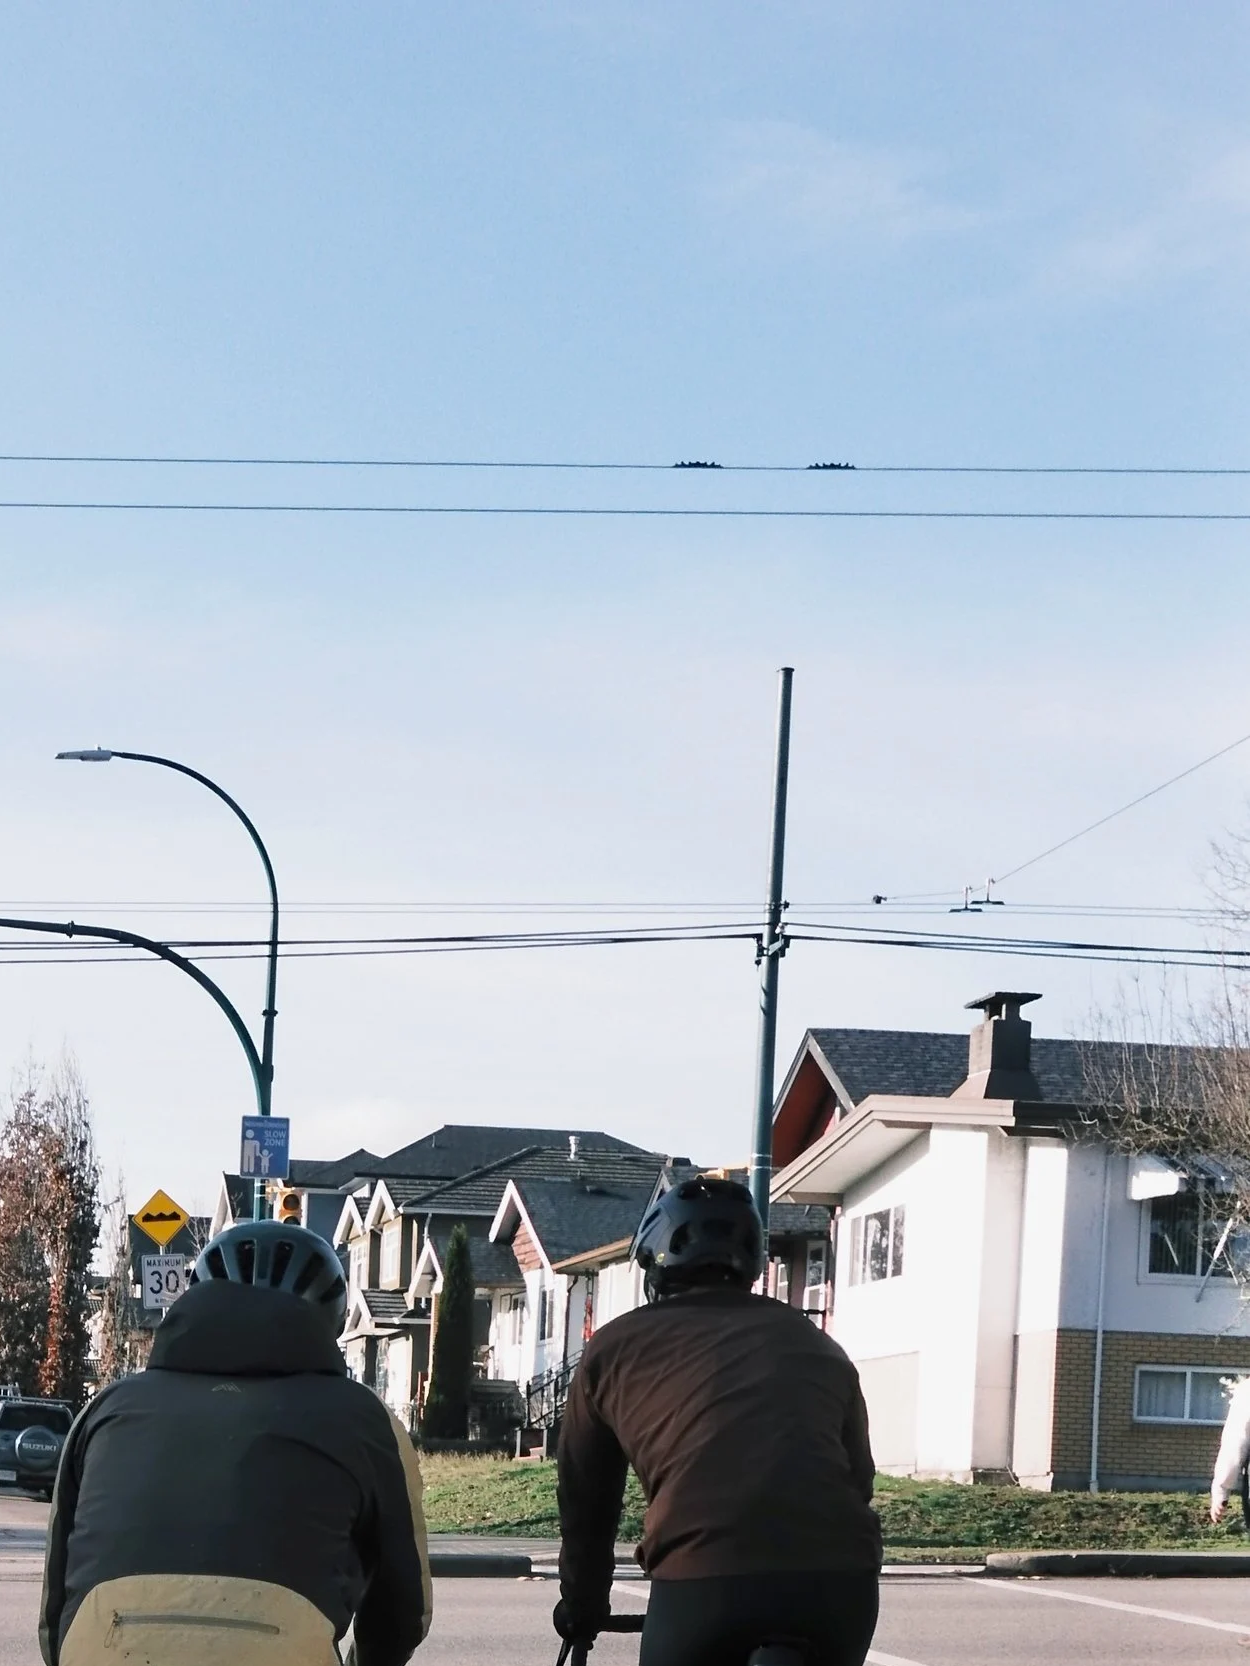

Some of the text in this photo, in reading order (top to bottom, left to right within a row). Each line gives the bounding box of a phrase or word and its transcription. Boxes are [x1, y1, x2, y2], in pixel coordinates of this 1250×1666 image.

[264, 1130, 287, 1139] SLOW
[264, 1139, 285, 1147] ZONE
[146, 1259, 181, 1267] MAXIMUM
[150, 1269, 179, 1294] 30
[22, 1442, 57, 1452] SUZUKI
